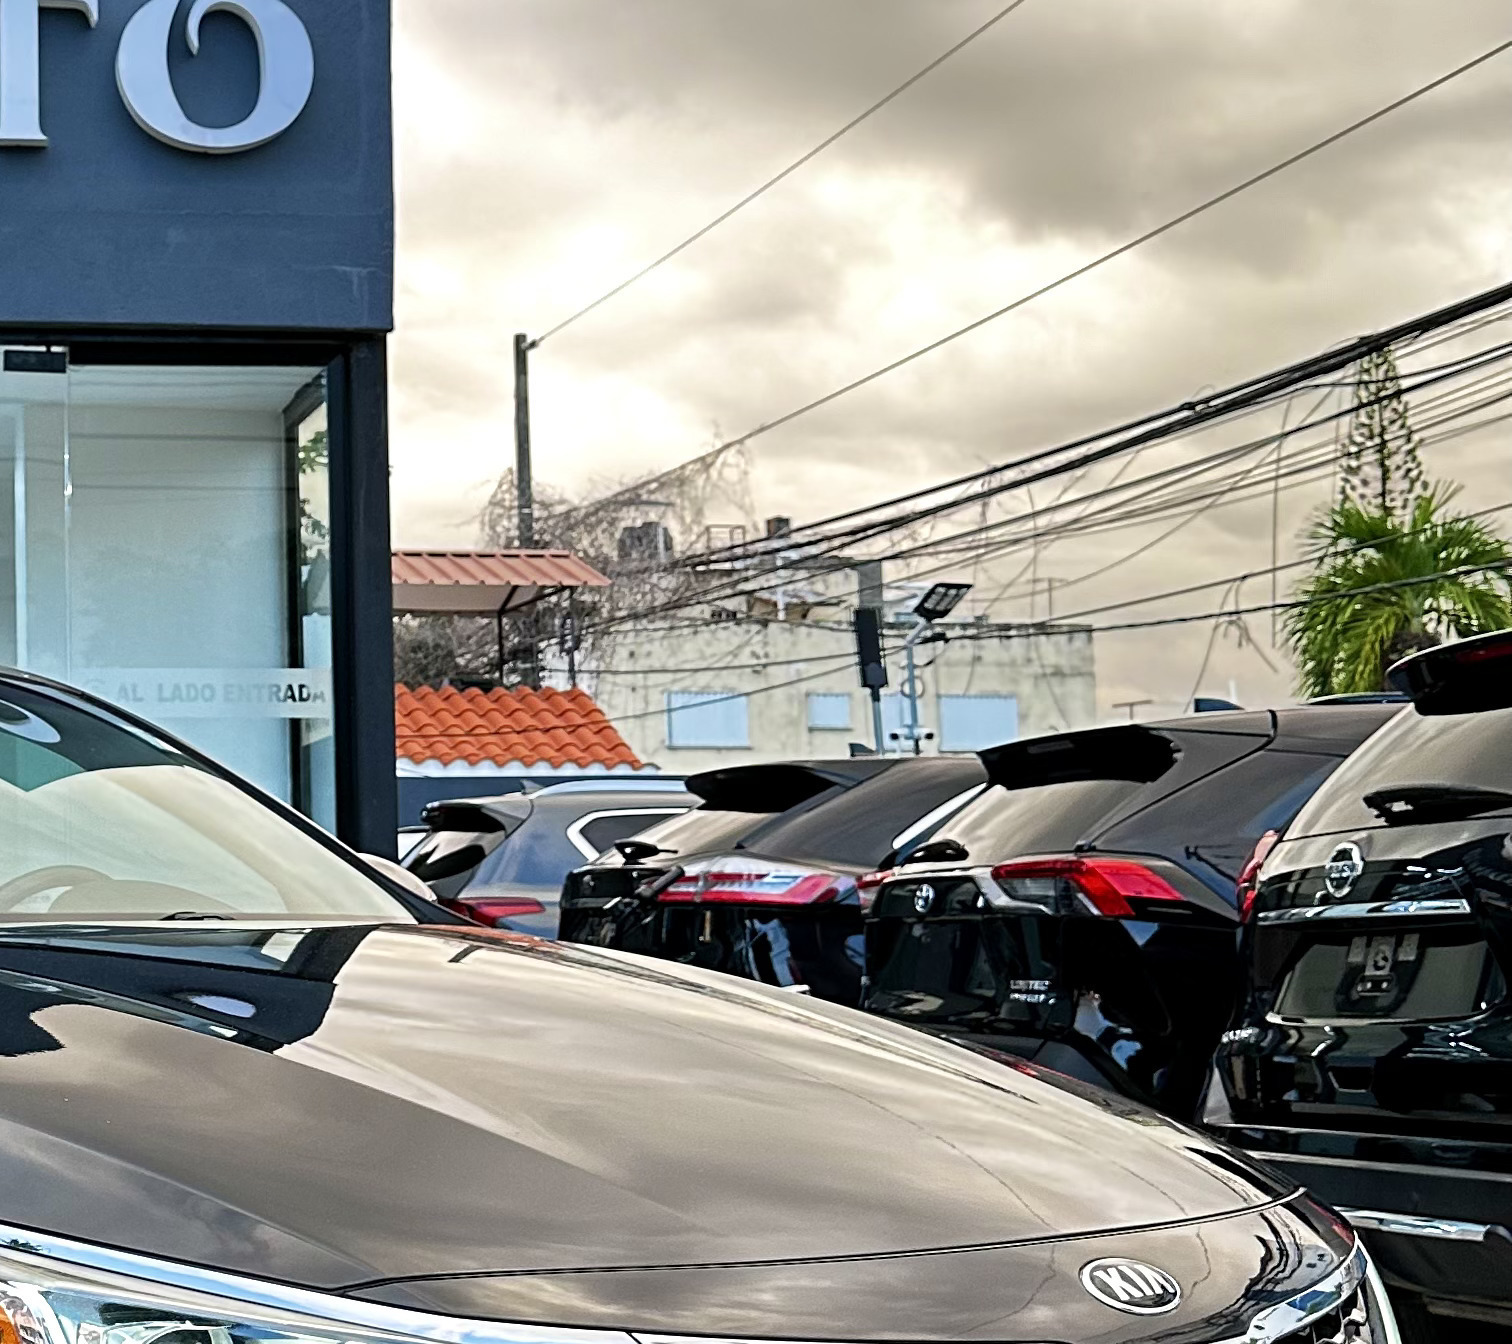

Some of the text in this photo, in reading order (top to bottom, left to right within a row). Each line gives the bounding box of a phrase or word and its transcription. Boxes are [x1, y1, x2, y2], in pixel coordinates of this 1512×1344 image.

[116, 682, 145, 703] AL
[156, 682, 216, 704] LADO
[1092, 1263, 1176, 1302] KIA
